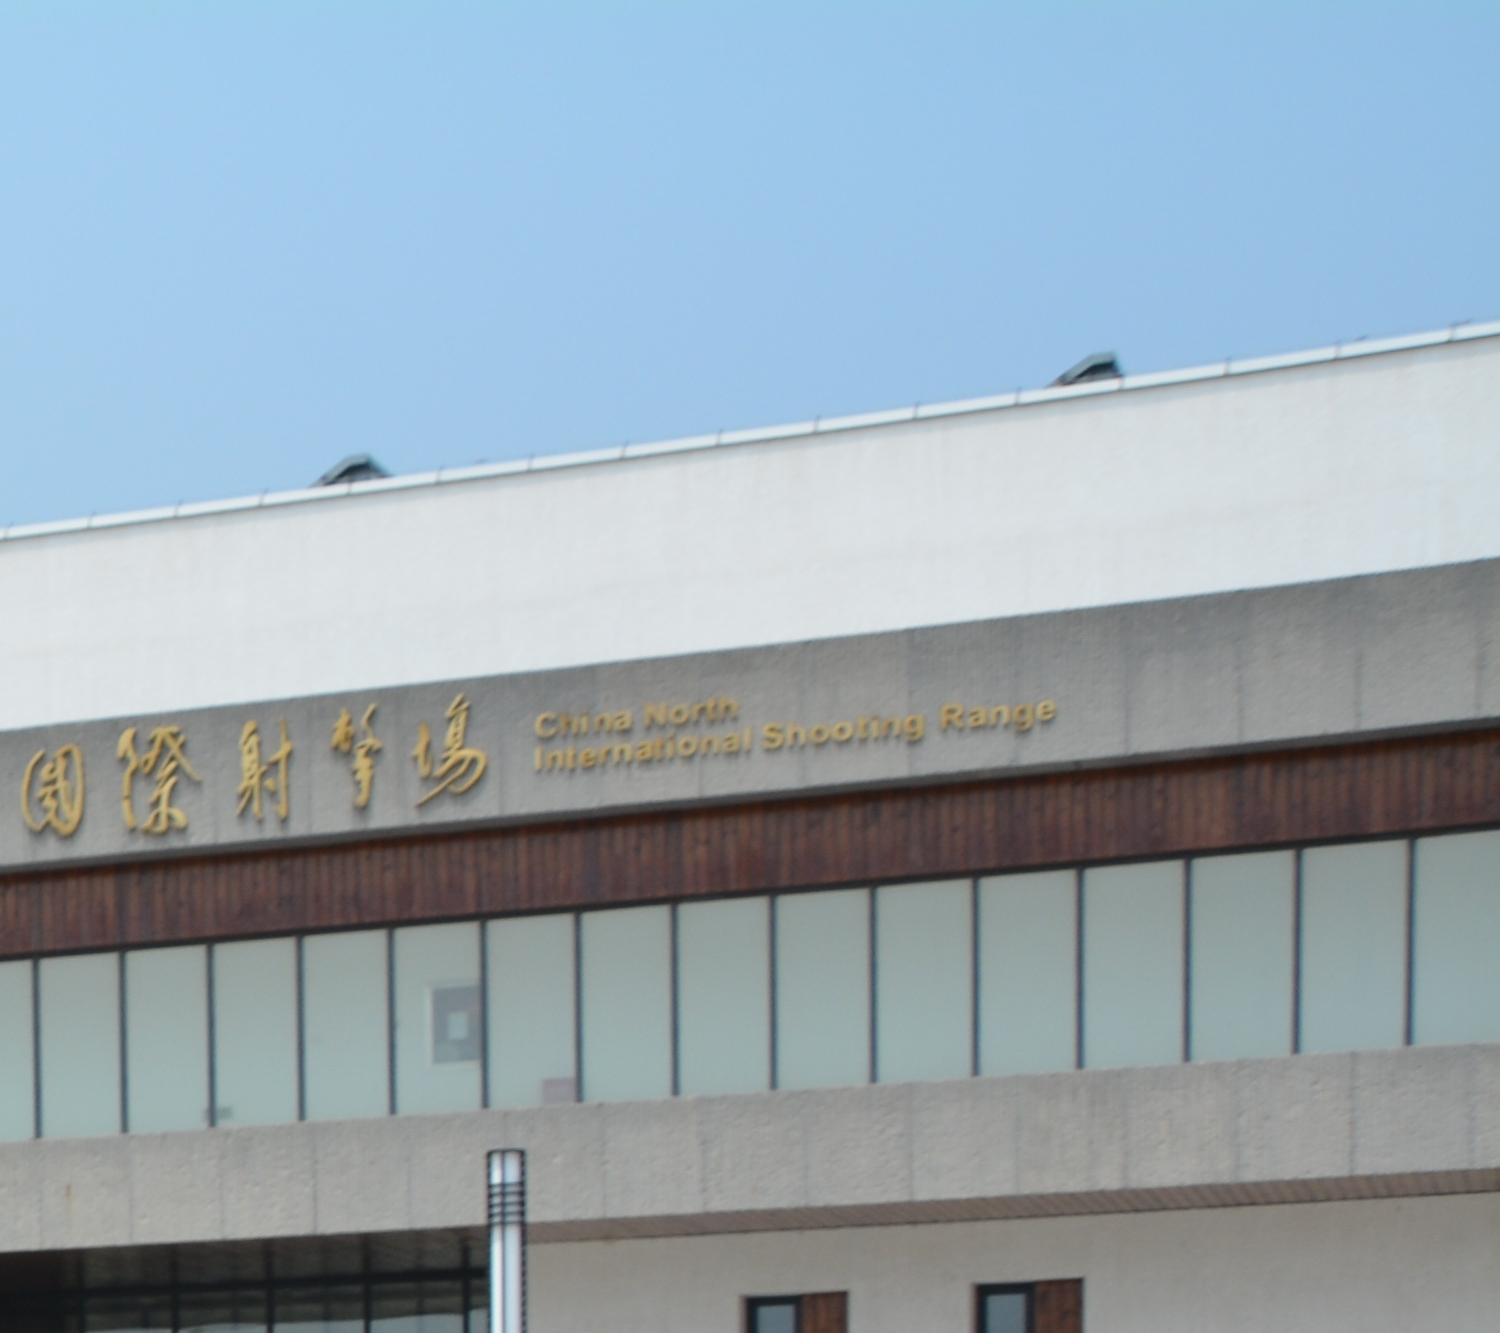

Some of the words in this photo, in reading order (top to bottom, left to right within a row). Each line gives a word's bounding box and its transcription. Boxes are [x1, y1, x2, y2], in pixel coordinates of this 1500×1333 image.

[534, 709, 632, 739] China
[644, 696, 740, 728] North
[534, 726, 752, 771] International
[761, 710, 926, 751] Shooting
[939, 698, 1057, 735] Range
